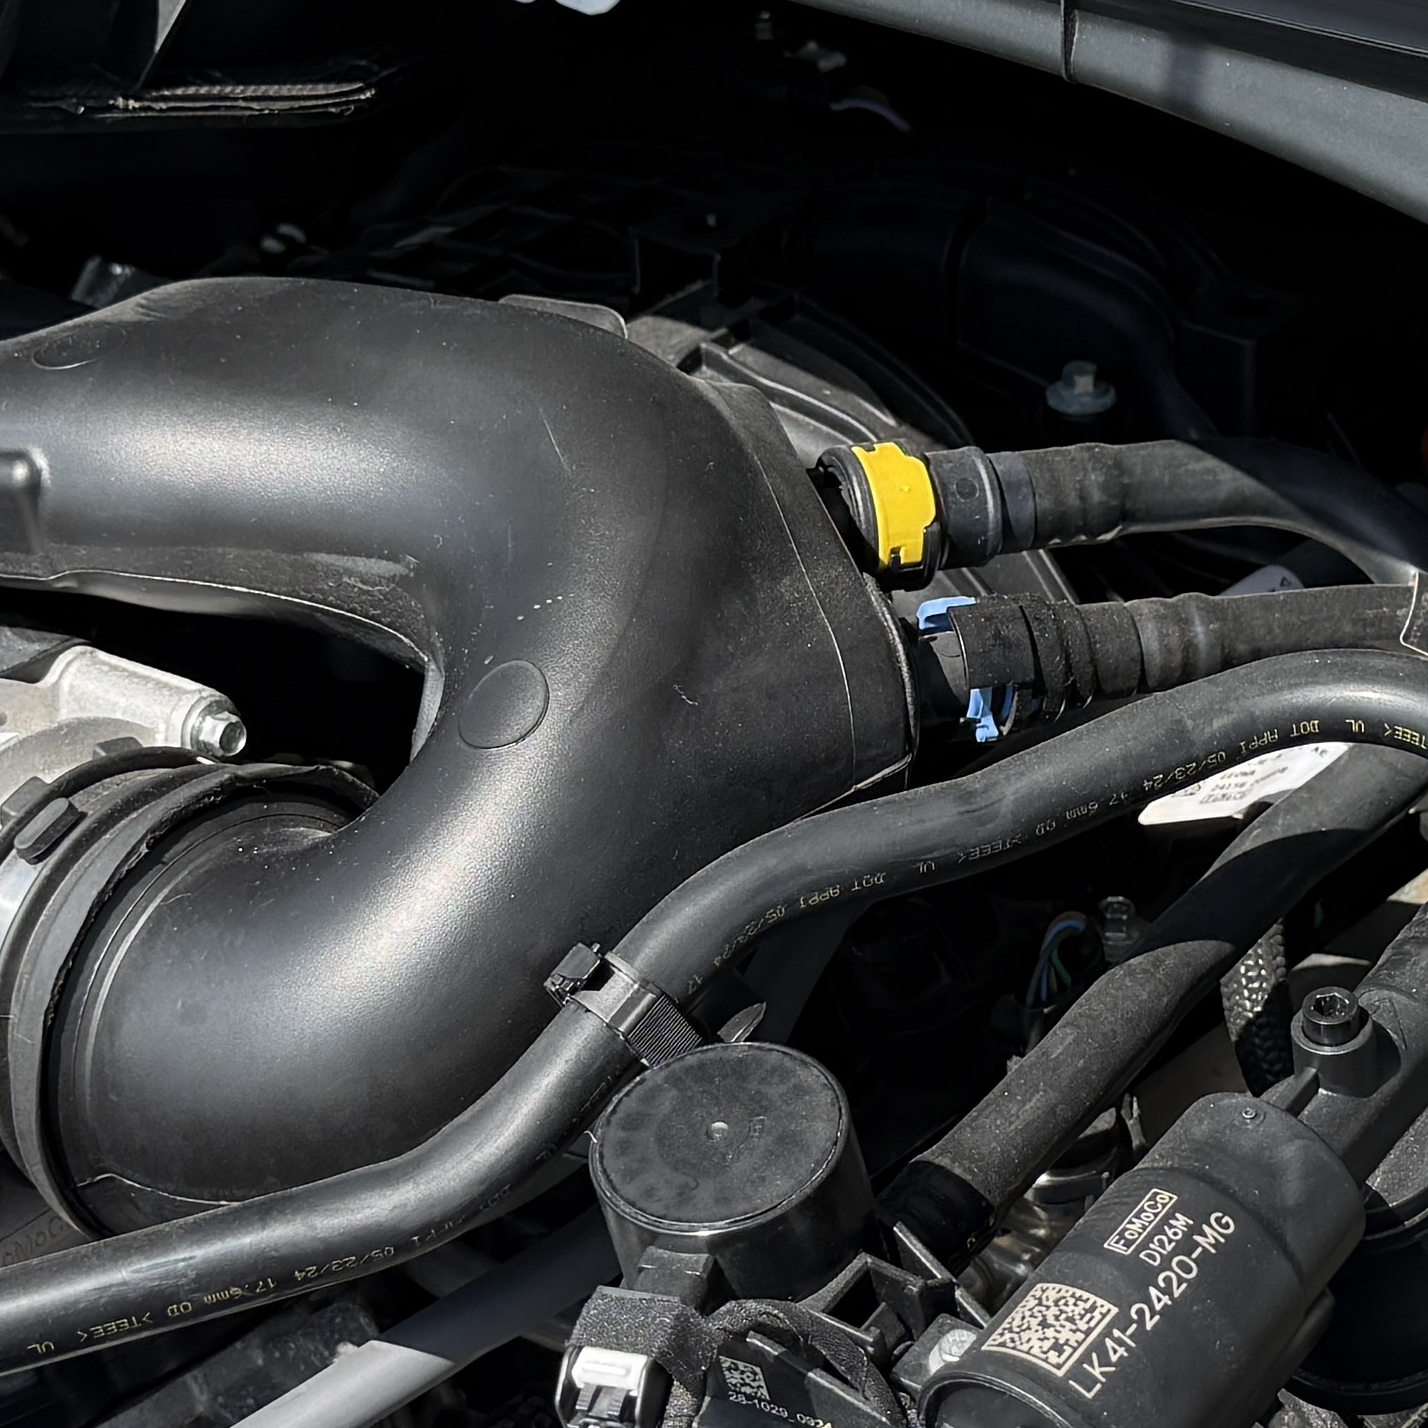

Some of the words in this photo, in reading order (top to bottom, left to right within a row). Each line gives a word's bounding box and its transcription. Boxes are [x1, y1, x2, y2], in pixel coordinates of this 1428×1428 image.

[1290, 719, 1320, 738] DOT
[1345, 718, 1365, 733] UL
[1240, 728, 1279, 757] APPI
[1142, 750, 1227, 792] 05/23/24
[1109, 1193, 1170, 1252] FoMoCo
[203, 1274, 278, 1305] 17.6mm
[167, 1299, 193, 1318] OD
[1068, 1210, 1237, 1400] LK41-2420-MG
[28, 1338, 55, 1355] UL
